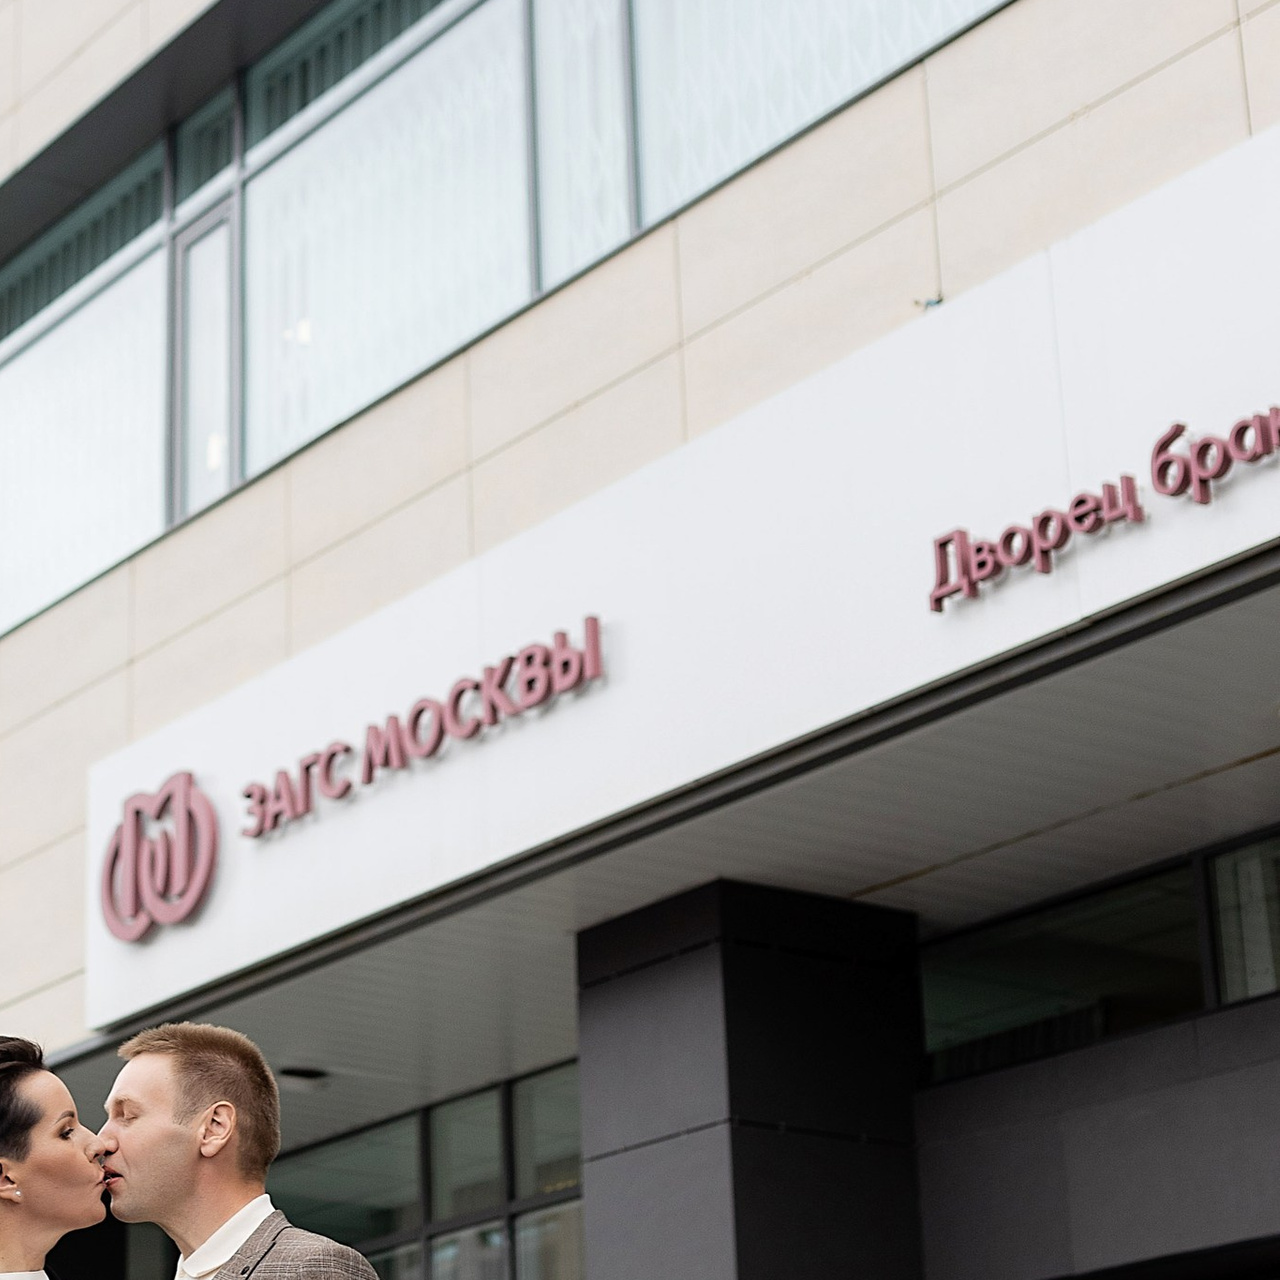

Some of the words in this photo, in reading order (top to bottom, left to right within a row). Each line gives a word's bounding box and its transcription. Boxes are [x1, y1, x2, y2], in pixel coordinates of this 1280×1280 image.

[930, 474, 1146, 612] Дворец
[241, 741, 352, 839] ЗАГС
[360, 616, 604, 785] МОСКВЫ
